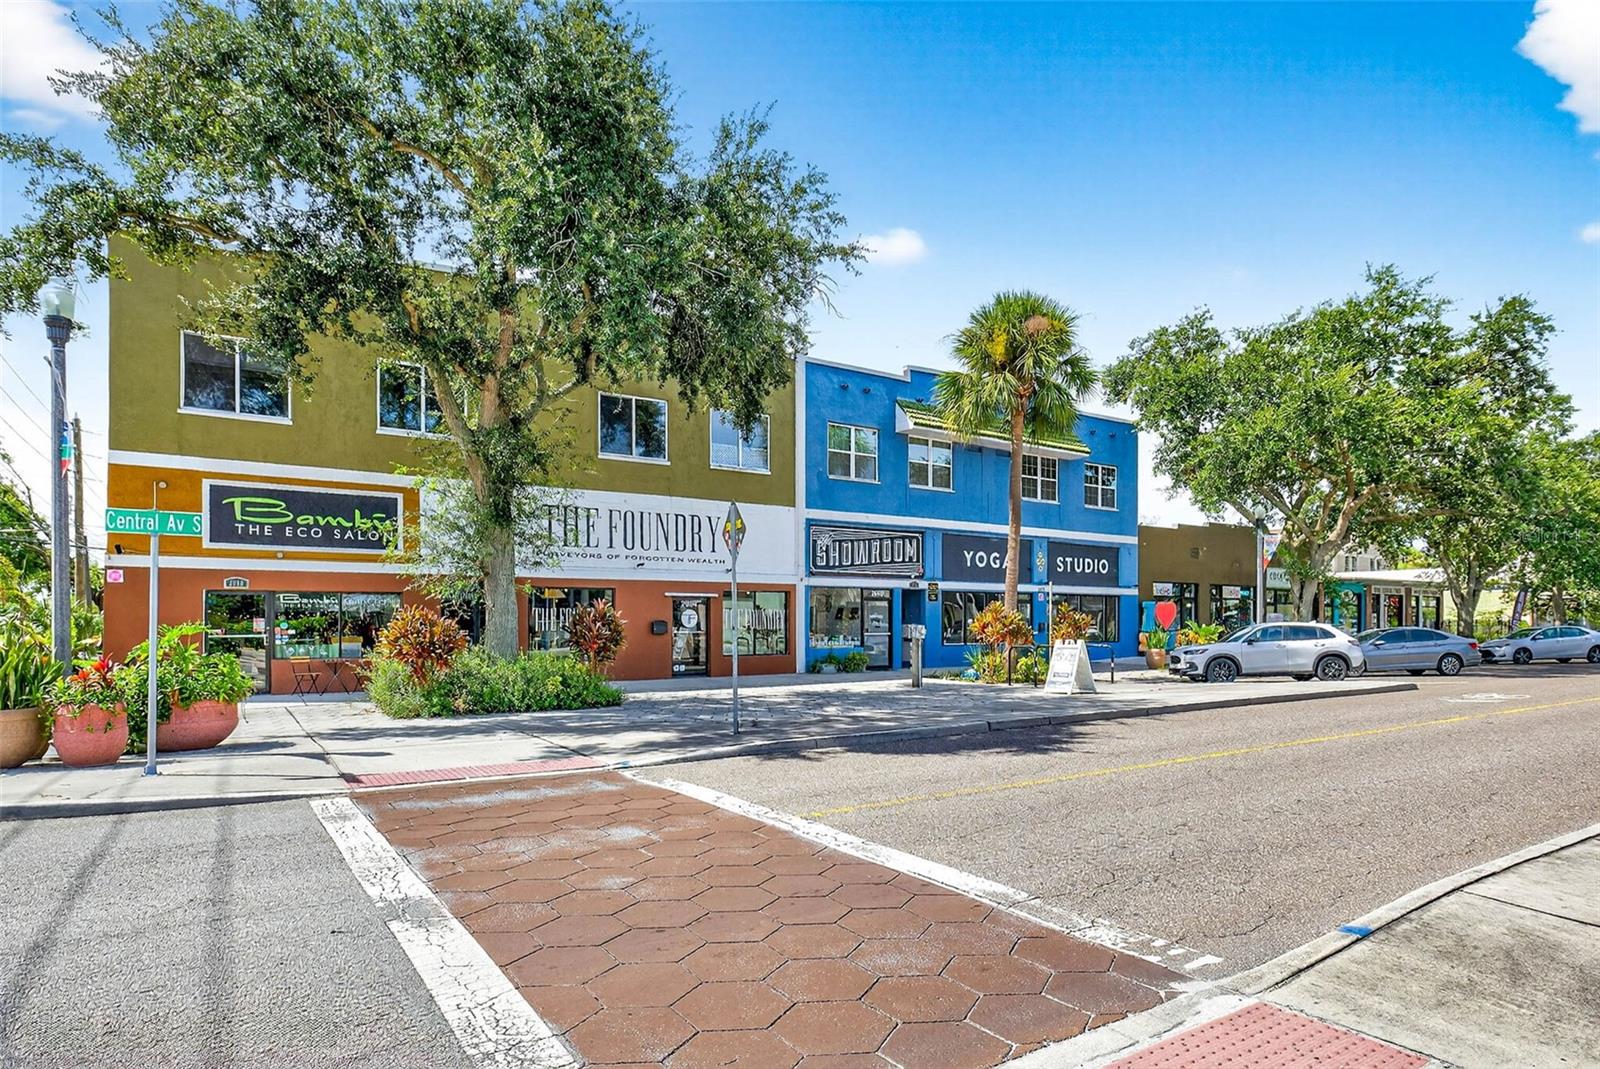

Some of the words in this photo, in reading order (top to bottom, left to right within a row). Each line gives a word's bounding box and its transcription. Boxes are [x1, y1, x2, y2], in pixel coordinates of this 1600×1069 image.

[106, 510, 159, 531] Central
[167, 514, 184, 532] Av
[192, 515, 201, 533] S
[235, 523, 272, 536] THE
[285, 526, 322, 538] ECO
[333, 528, 394, 541] SALON
[541, 504, 600, 549] THE
[607, 508, 721, 553] FOUNDRY
[624, 554, 684, 563] FORGOTTEN
[687, 557, 726, 565] WEALTH
[815, 538, 917, 566] SHOWROOM
[1056, 556, 1109, 574] STUDIO
[532, 607, 557, 632] THE
